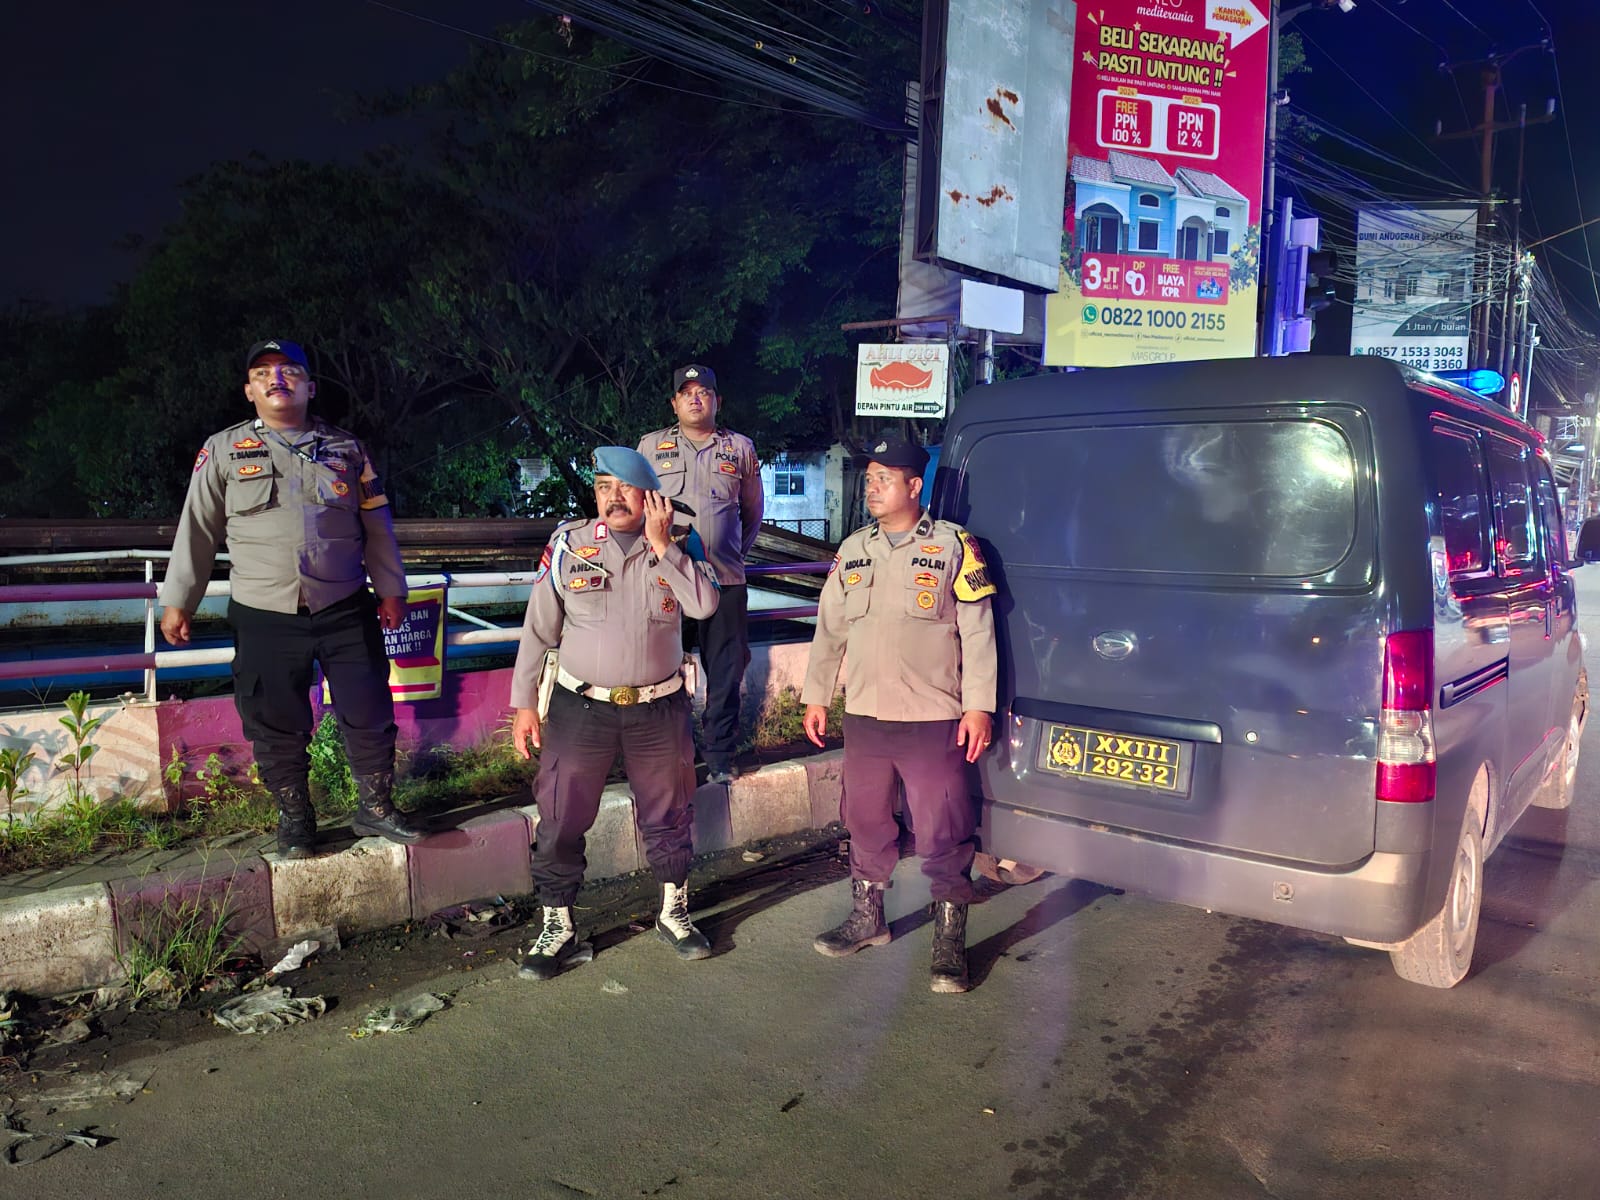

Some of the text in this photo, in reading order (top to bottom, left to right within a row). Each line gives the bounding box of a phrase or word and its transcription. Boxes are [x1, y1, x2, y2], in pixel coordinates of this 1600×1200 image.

[1136, 5, 1195, 23] mediterania
[1100, 25, 1226, 63] BELI SEKARANG
[1098, 51, 1142, 75] PASTI
[1146, 61, 1210, 87] UNTUNG
[1115, 100, 1138, 115] FREE
[1115, 114, 1138, 130] PPN
[1178, 111, 1204, 131] PPN
[1112, 128, 1130, 142] 100
[1177, 130, 1190, 145] 12
[1133, 260, 1146, 271] DP
[1162, 263, 1181, 274] FREE
[1084, 258, 1120, 290] 3 JT
[1157, 274, 1185, 286] BIAYA
[1161, 286, 1180, 298] KPR
[1101, 307, 1226, 331] 0822 1000 2155
[1441, 323, 1466, 331] bulan
[1368, 347, 1463, 356] 0857 1533 3043
[1433, 359, 1462, 369] 3360
[857, 402, 878, 410] DEPAN
[715, 453, 739, 464] POLRI
[911, 557, 946, 571] POLRI
[411, 609, 429, 621] BAN
[384, 629, 432, 646] AN HARGA
[1095, 735, 1170, 762] XXIII
[1092, 756, 1169, 785] 292-32
